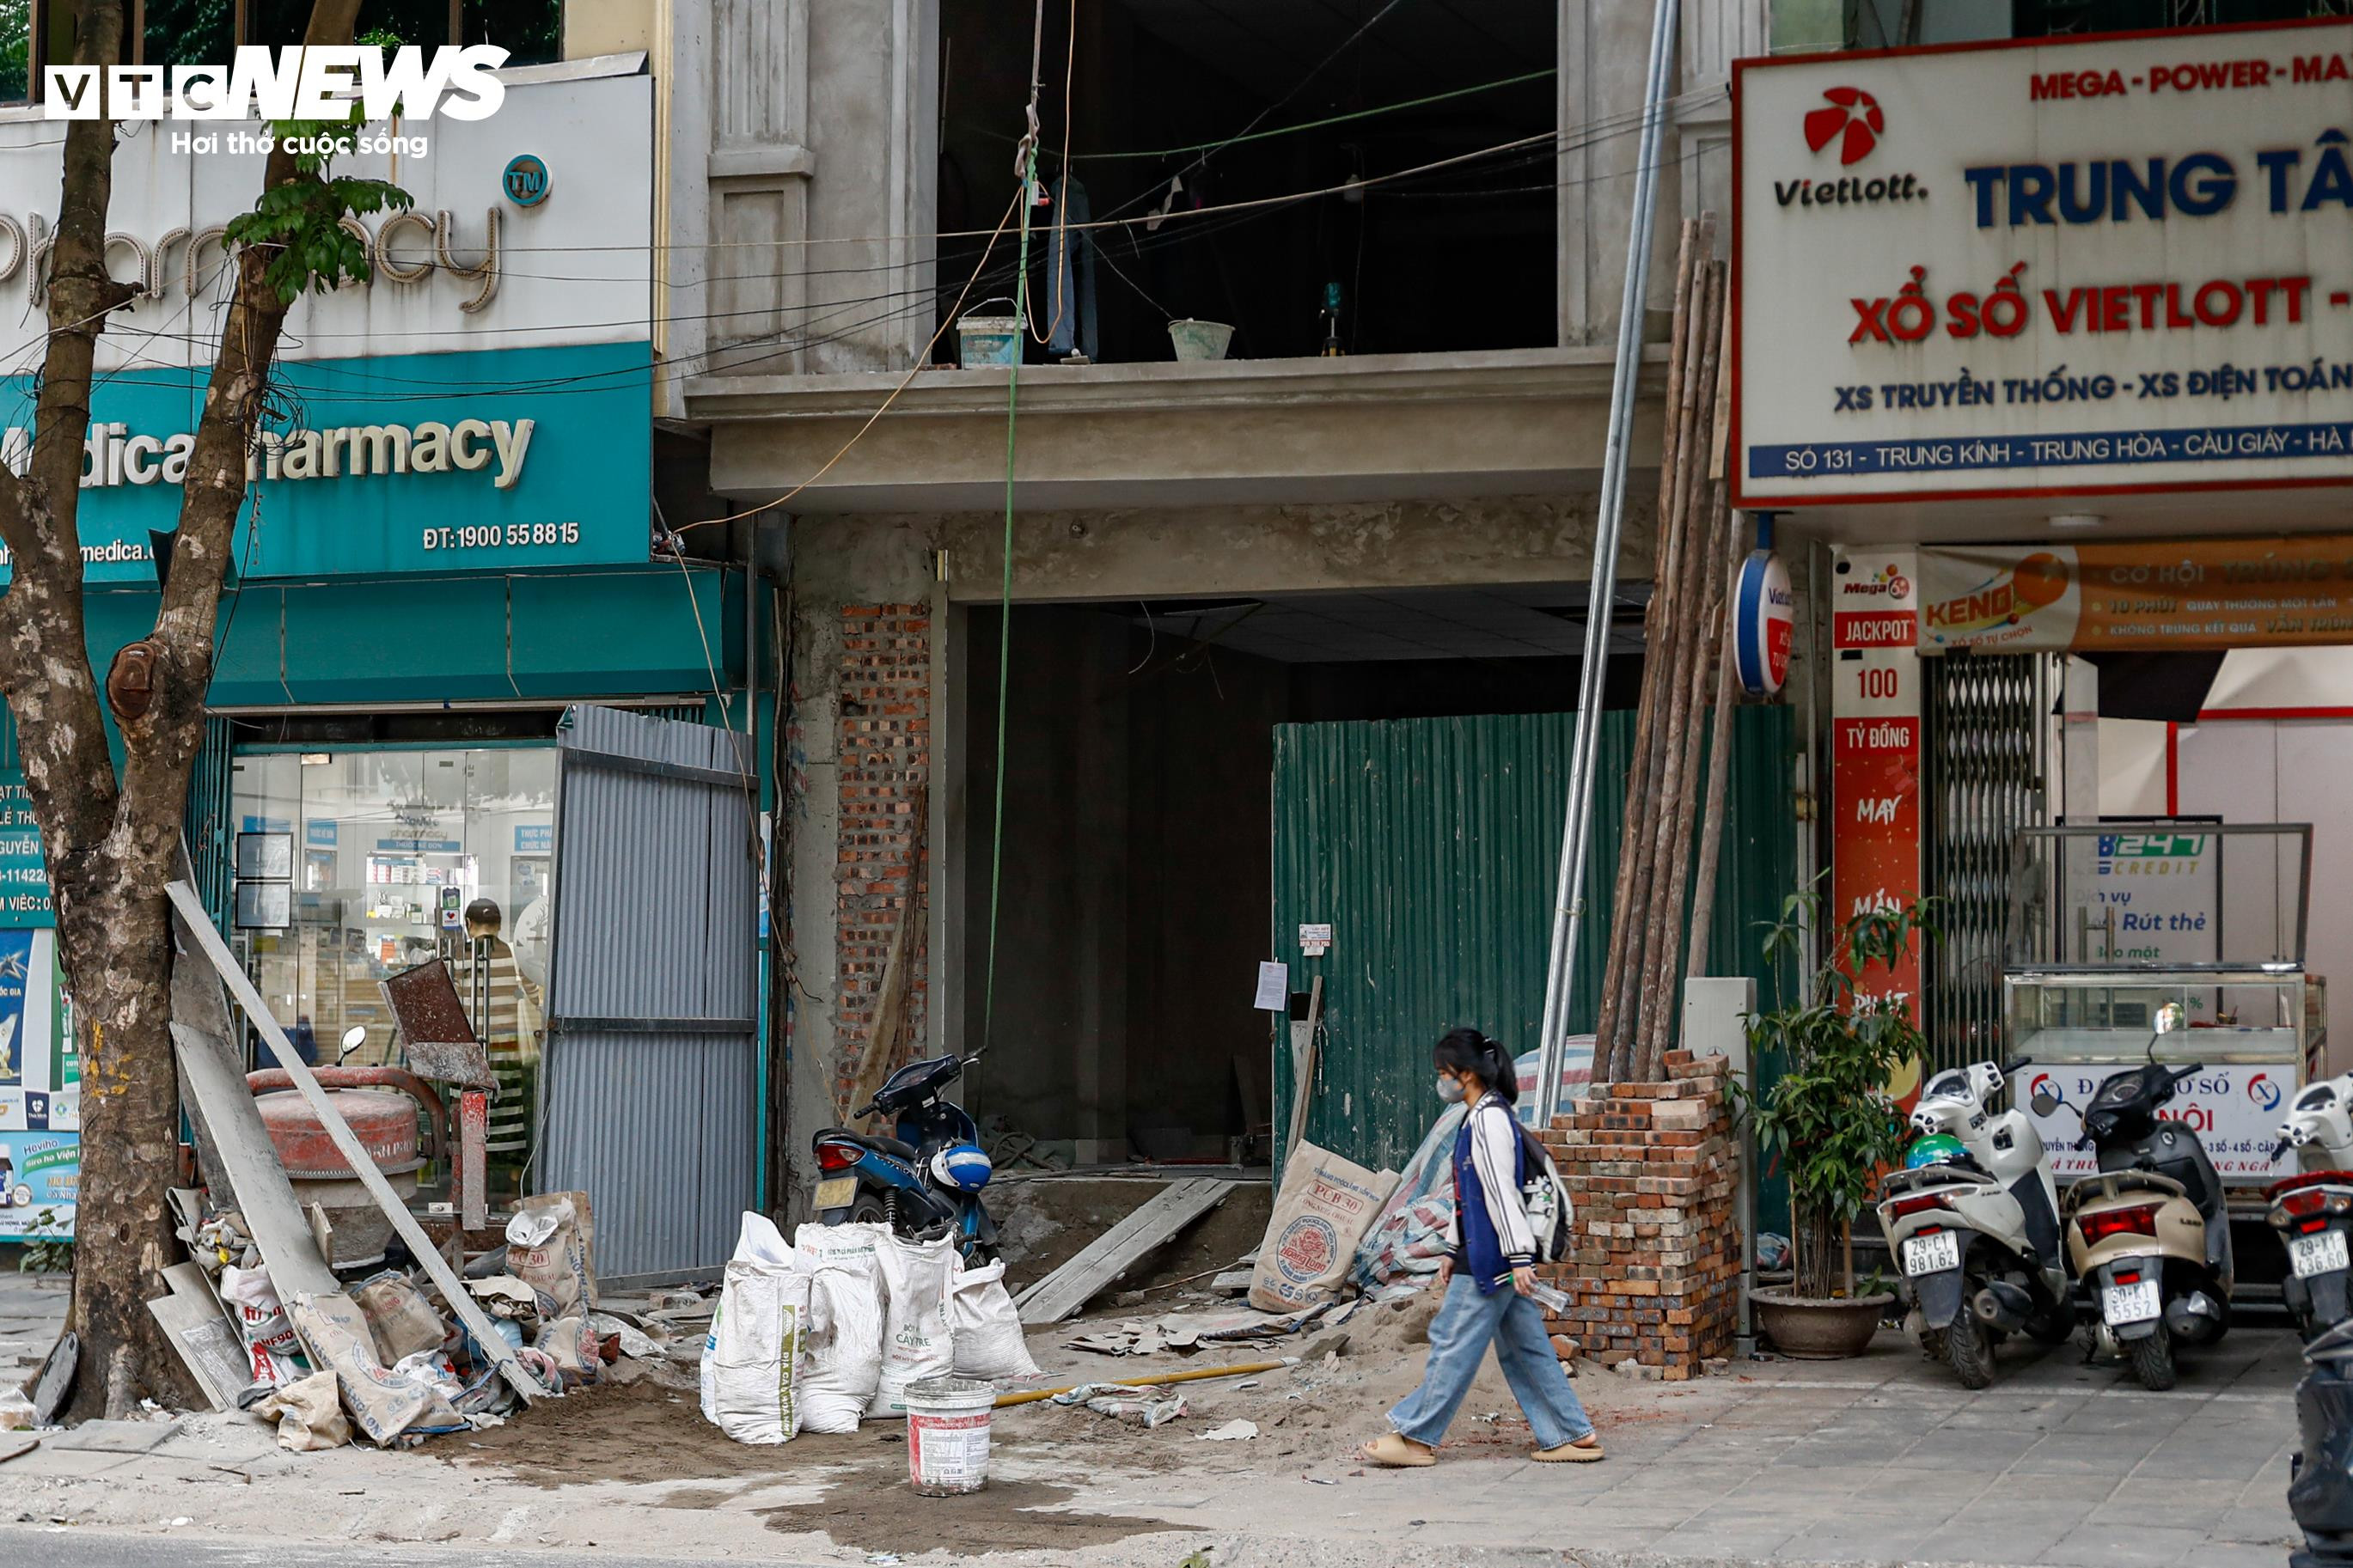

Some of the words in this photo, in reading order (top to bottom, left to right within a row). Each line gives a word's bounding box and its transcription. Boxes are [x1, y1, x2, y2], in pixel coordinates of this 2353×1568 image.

[2030, 70, 2127, 101] MEGA
[2149, 58, 2270, 95] POWER
[2292, 52, 2353, 84] MA
[506, 170, 541, 193] TM
[1965, 151, 2239, 229] TRUNG
[1848, 265, 1935, 345] XỔ
[1946, 260, 2029, 339] SỐ
[2043, 276, 2312, 335] VIETLOTT
[1833, 386, 1873, 414] XS
[1880, 366, 1995, 411] TRUYỀN
[2003, 363, 2117, 403] THỐNG
[2137, 372, 2180, 400] XS
[2187, 363, 2258, 401] ĐIỆN
[2264, 357, 2353, 394] TOÁN
[246, 418, 535, 491] harmacy
[1785, 446, 1818, 471] SỐ
[1823, 448, 1853, 470] 131
[1875, 444, 1954, 467] TRUNG
[1960, 439, 2011, 464] KÍNH
[2030, 437, 2111, 463] TRUNG
[2116, 432, 2167, 458] HÒA
[2185, 429, 2234, 456] CẦU
[2239, 427, 2290, 454] GIẤY
[2309, 427, 2344, 451] HÀ
[1843, 582, 1888, 595] Mega
[1926, 583, 2014, 627] KENO
[1845, 619, 1911, 642] JACKPOT
[1857, 668, 1898, 699] 100
[1869, 721, 1910, 747] ĐỒNG
[1856, 794, 1904, 826] MAY
[2114, 861, 2199, 876] CREDIT
[2111, 892, 2131, 906] vụ
[2123, 912, 2163, 931] Rút
[2169, 912, 2207, 931] thẻ
[2199, 1071, 2230, 1095] SỐ
[23, 1139, 58, 1156] Heviho
[1313, 1183, 1342, 1205] PCB
[1342, 1197, 1358, 1211] 30
[1912, 1235, 1947, 1256] 29-C1
[1910, 1250, 1955, 1273] 981.62
[2112, 1300, 2153, 1321] 5552
